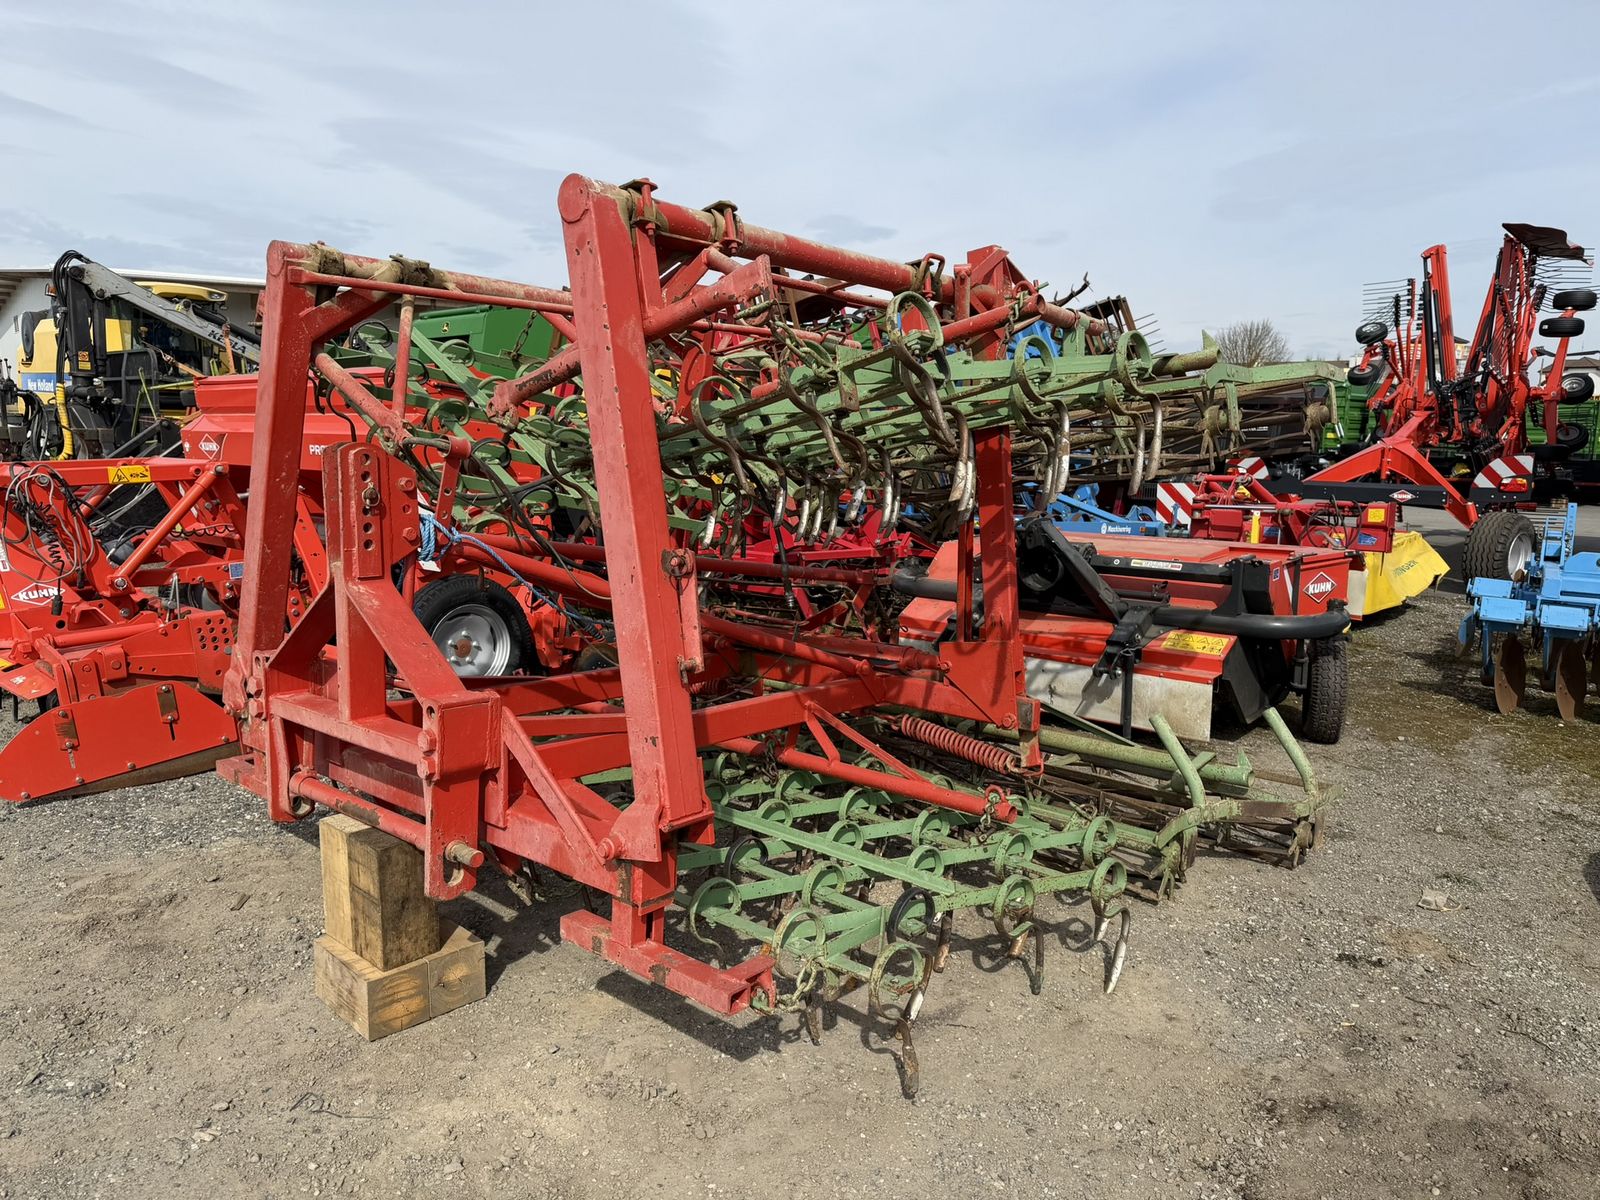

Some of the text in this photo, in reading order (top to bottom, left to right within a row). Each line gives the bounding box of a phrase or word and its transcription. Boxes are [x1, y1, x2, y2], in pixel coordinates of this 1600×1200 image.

[27, 379, 54, 391] New Holland
[18, 587, 59, 601] KUHN
[1308, 581, 1332, 595] KUHN
